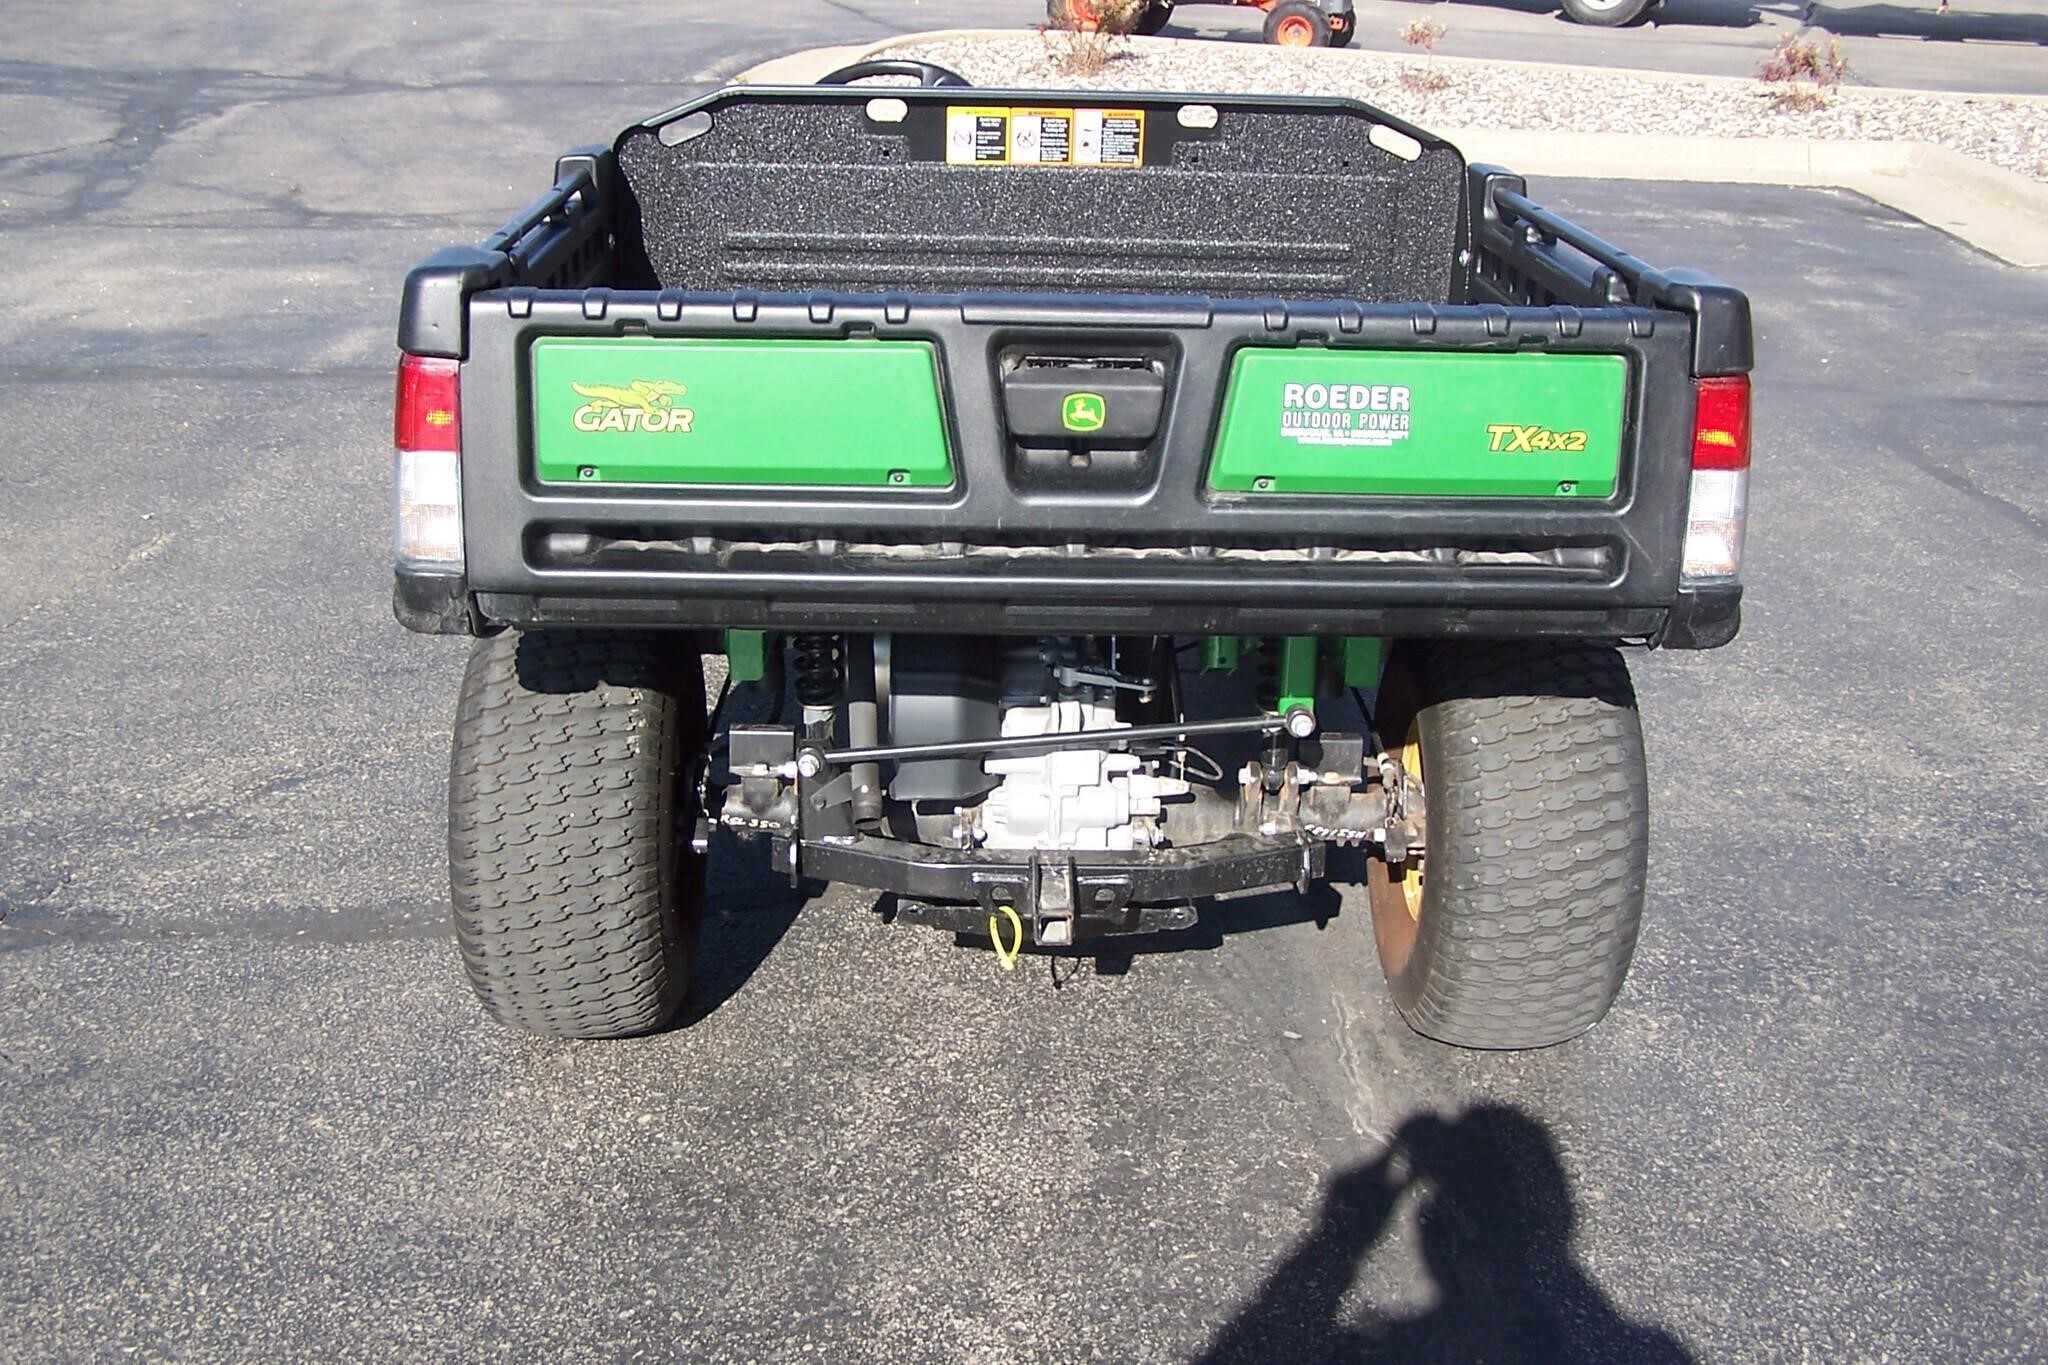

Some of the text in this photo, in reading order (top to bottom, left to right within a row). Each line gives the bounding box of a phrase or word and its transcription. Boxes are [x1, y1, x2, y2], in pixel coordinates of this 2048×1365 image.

[1283, 383, 1410, 411] ROEDER
[572, 404, 694, 433] GATOR
[1282, 411, 1410, 430] OUTDOOR POWER
